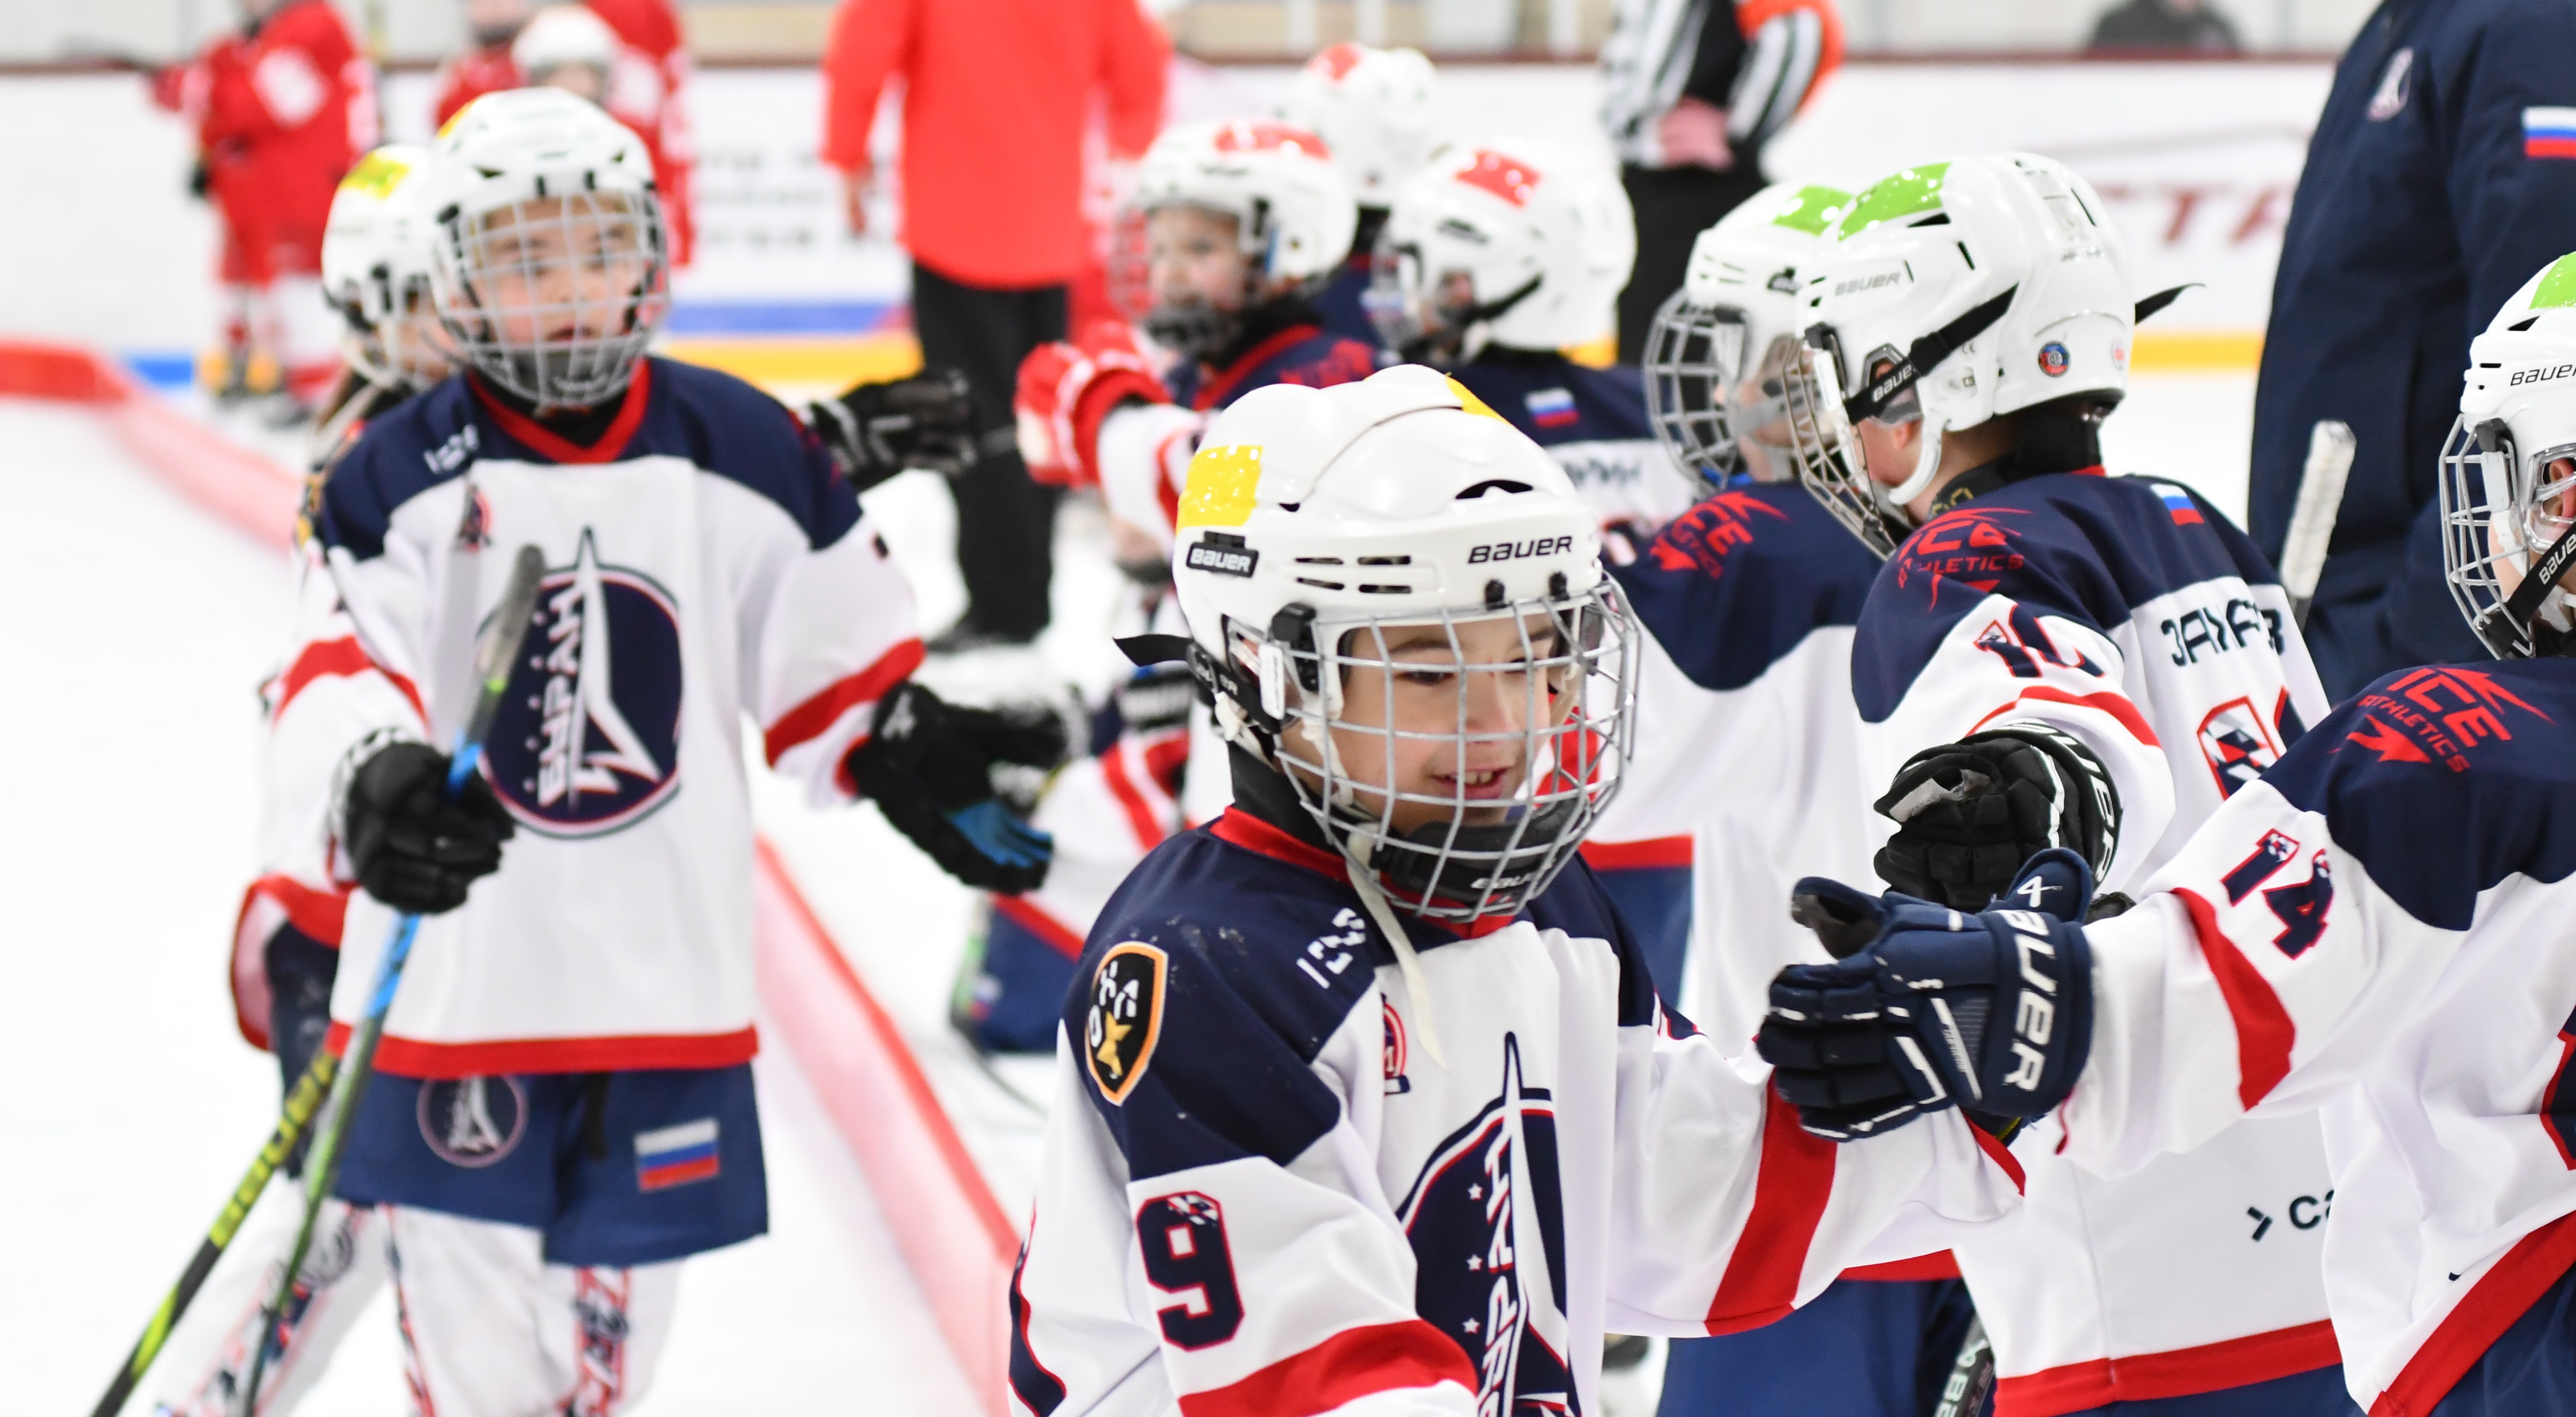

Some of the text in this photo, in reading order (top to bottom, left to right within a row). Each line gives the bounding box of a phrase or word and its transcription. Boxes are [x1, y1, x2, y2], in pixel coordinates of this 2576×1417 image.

[1874, 363, 1916, 403] BAUE
[2510, 364, 2576, 386] BAUE
[2357, 694, 2471, 772] ATHLETICS
[2386, 668, 2513, 747] ICE
[2219, 827, 2334, 961] 14
[1135, 1191, 1245, 1353] 9
